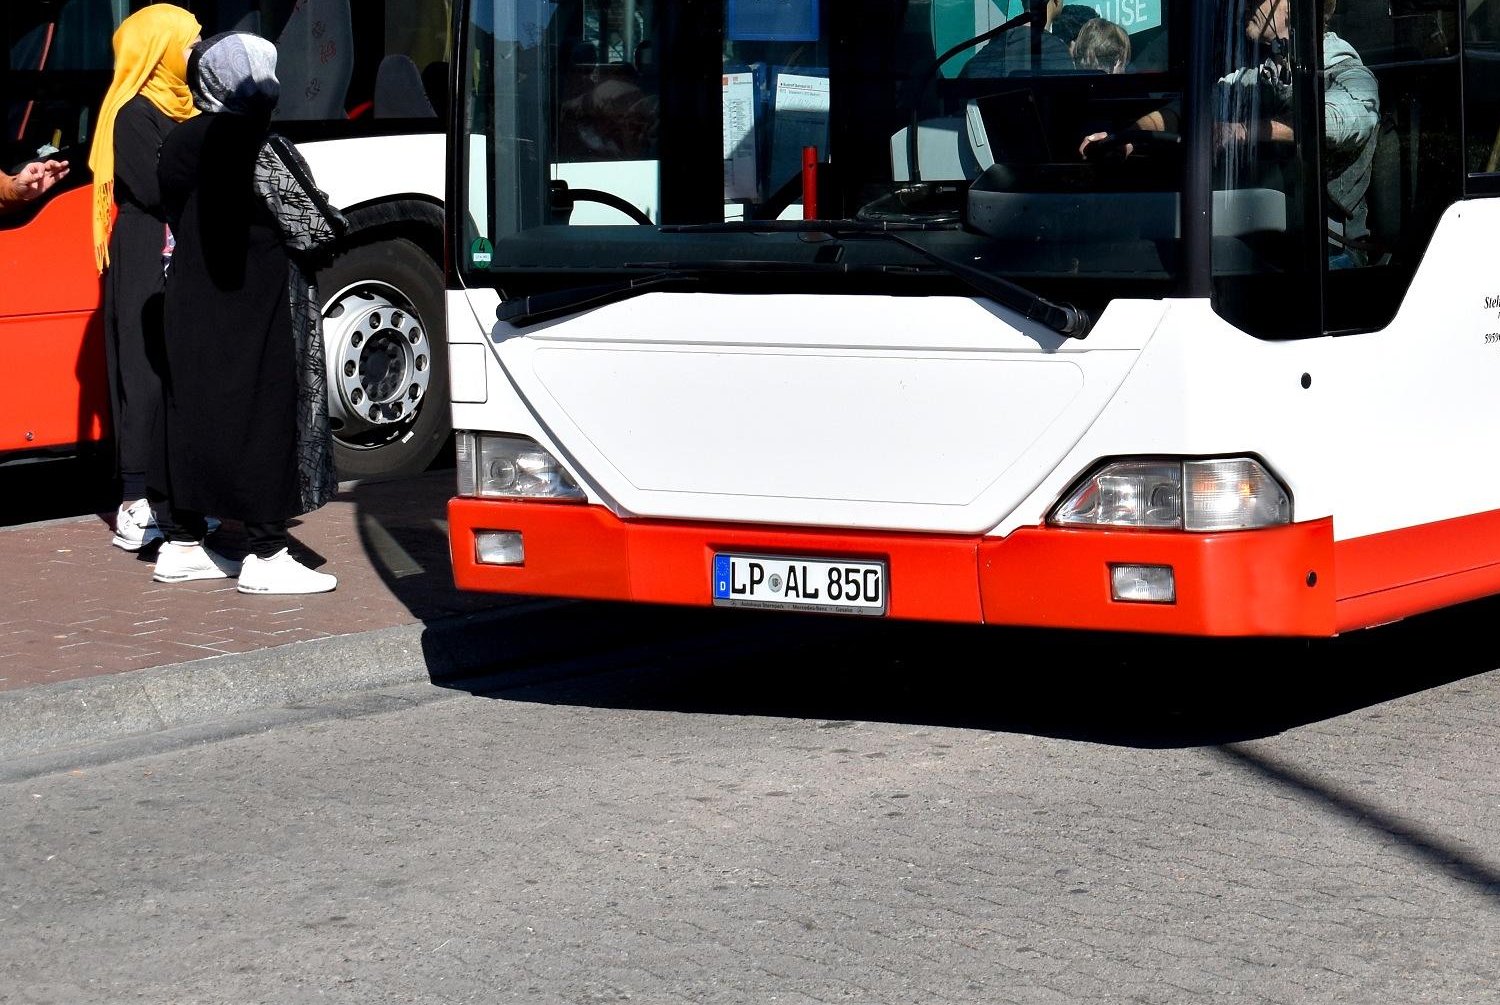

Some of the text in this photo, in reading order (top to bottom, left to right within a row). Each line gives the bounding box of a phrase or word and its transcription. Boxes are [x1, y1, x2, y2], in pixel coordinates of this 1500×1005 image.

[479, 239, 486, 253] 4
[720, 580, 726, 591] D
[731, 561, 880, 602] LP AL 850
